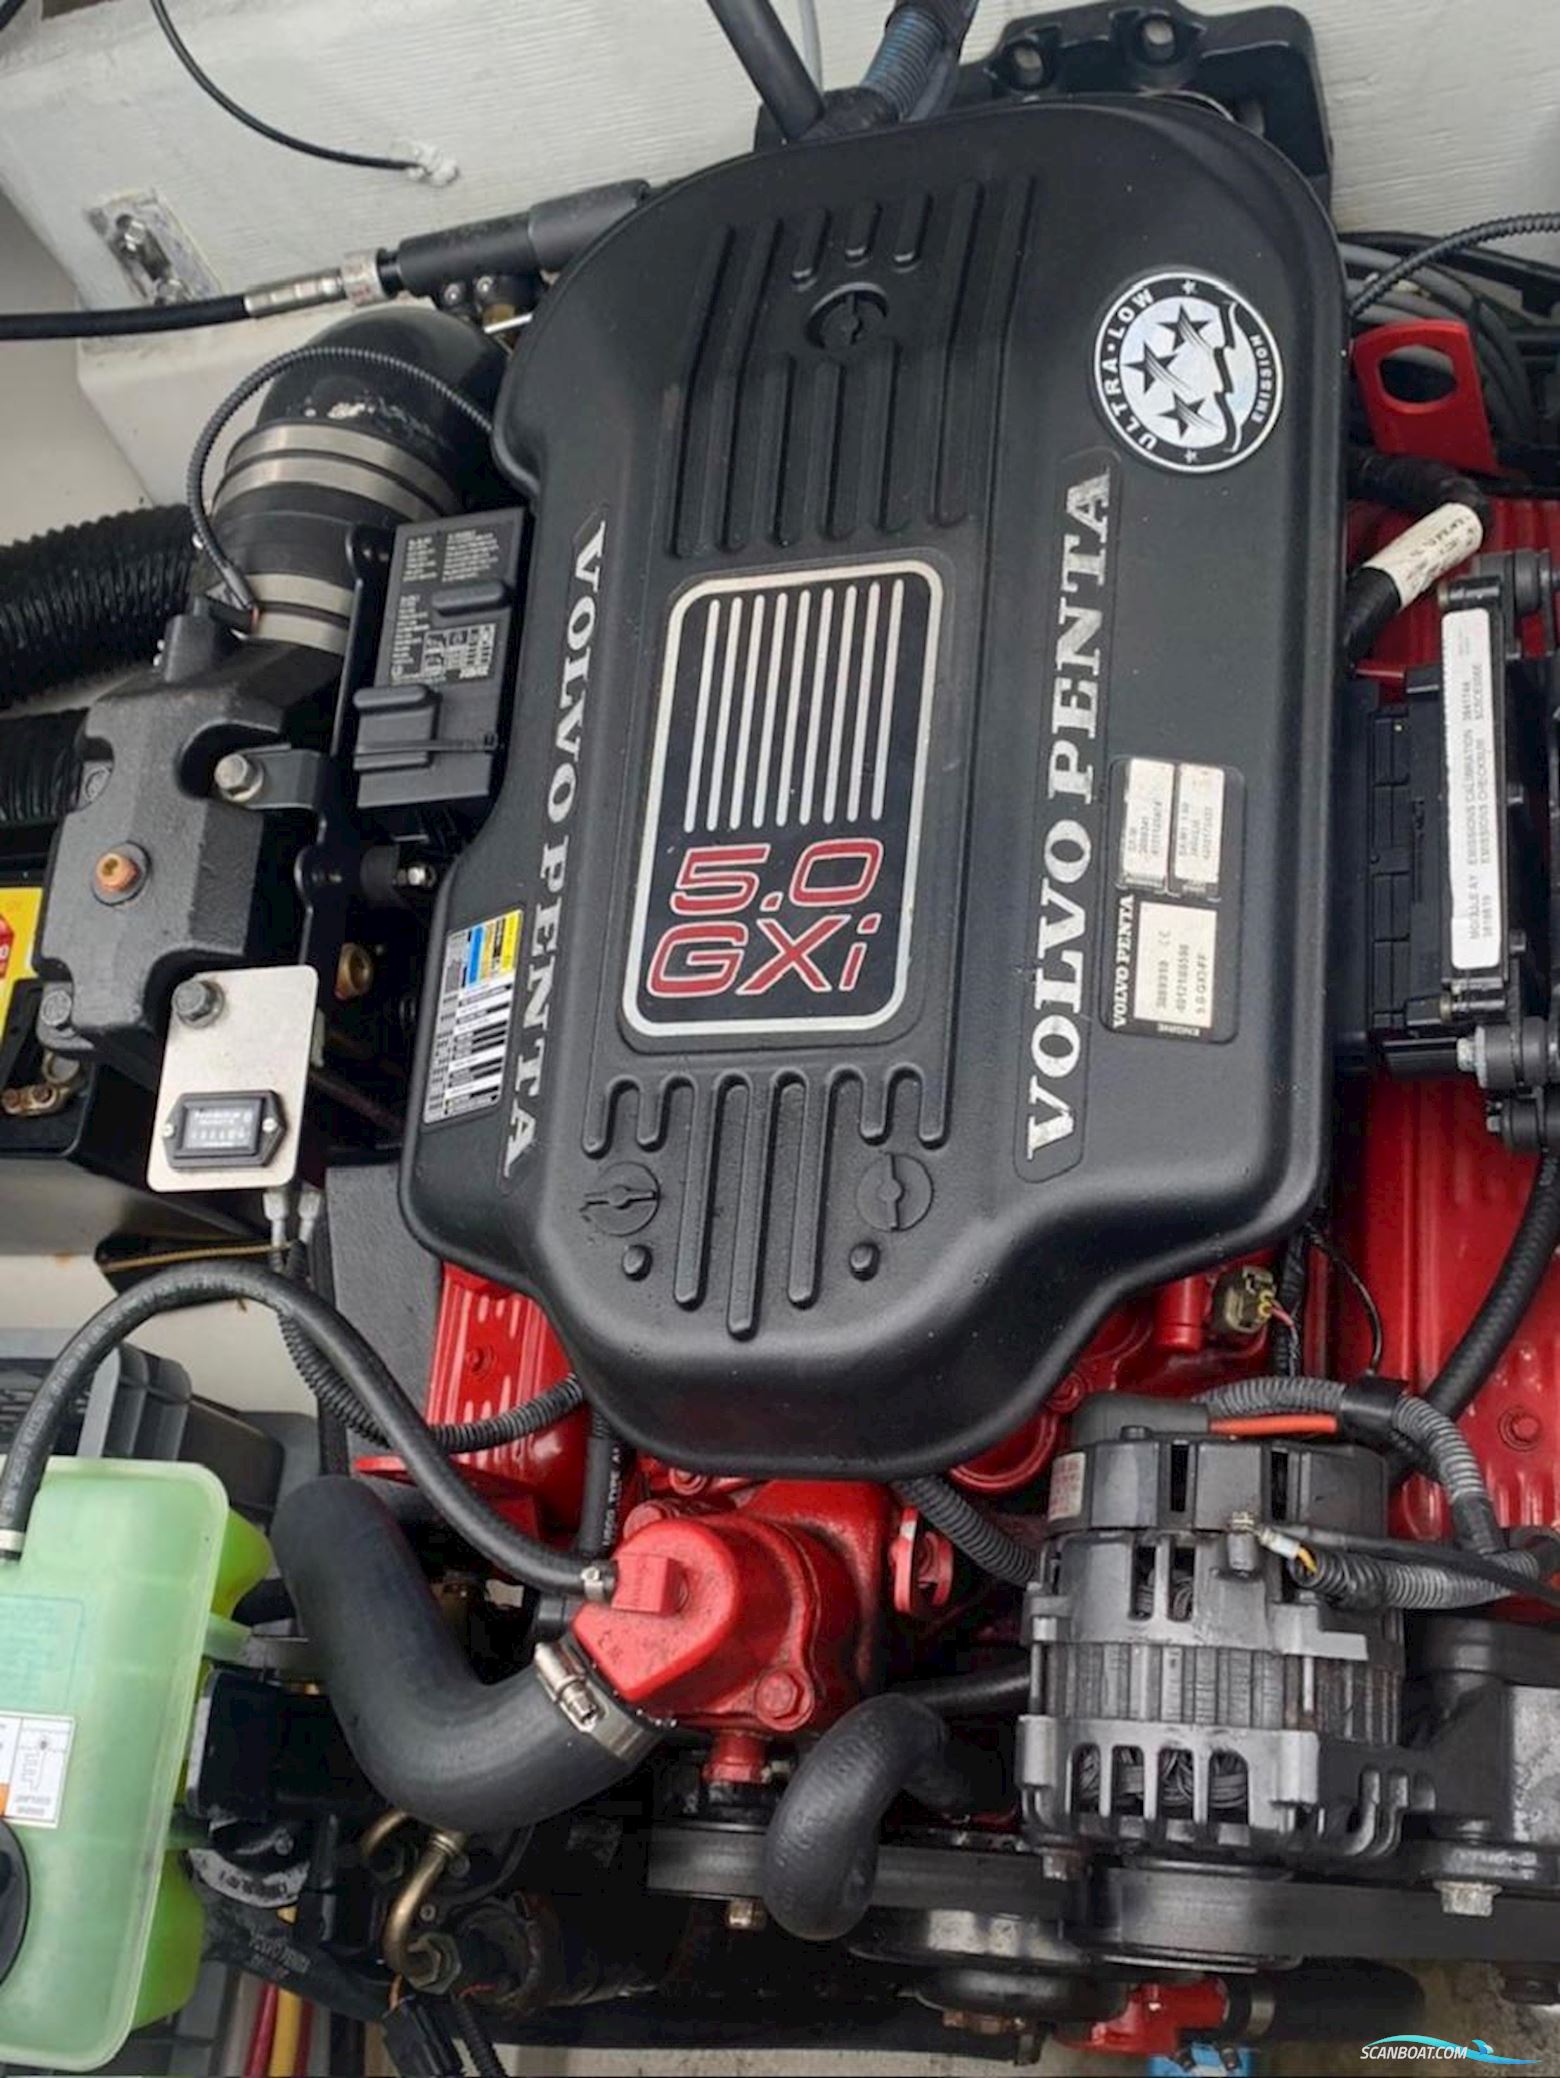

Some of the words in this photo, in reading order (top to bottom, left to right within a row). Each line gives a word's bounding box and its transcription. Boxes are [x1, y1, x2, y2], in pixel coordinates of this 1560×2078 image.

[1248, 334, 1273, 423] EMISSION
[547, 521, 606, 823] VOLVO
[1048, 467, 1111, 805] PENTA
[669, 837, 885, 915] 5.0
[646, 912, 882, 998] GXi
[1116, 894, 1134, 964] PENTA
[503, 834, 569, 1178] PENTA
[1026, 818, 1092, 1161] VOLVO
[1113, 964, 1129, 1029] VOLVO
